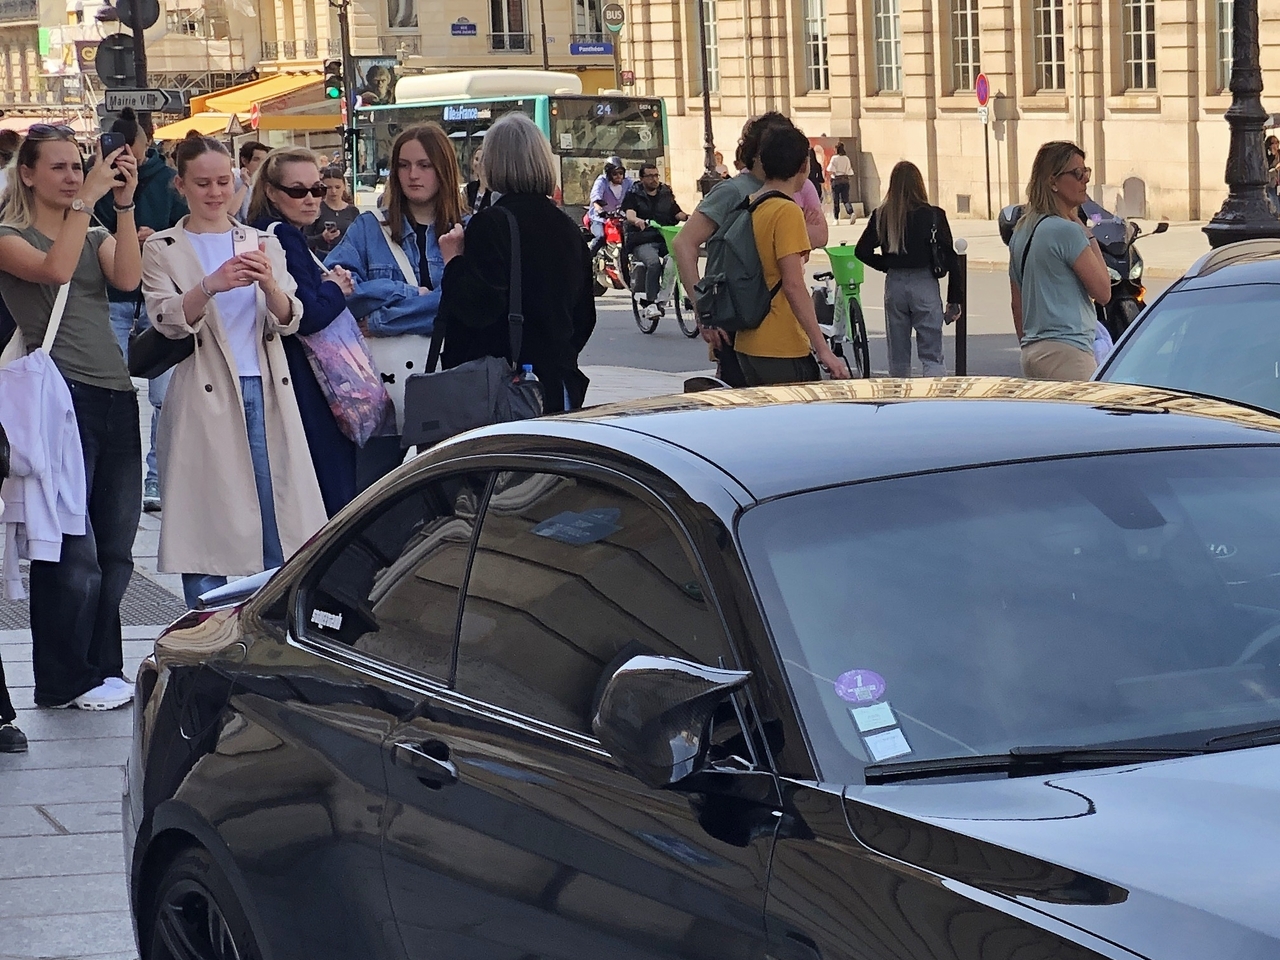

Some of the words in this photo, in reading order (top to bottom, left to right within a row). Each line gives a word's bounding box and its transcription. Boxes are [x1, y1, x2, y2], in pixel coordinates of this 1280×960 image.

[606, 10, 622, 20] BUS
[110, 95, 136, 106] Mairie
[597, 104, 610, 115] 24
